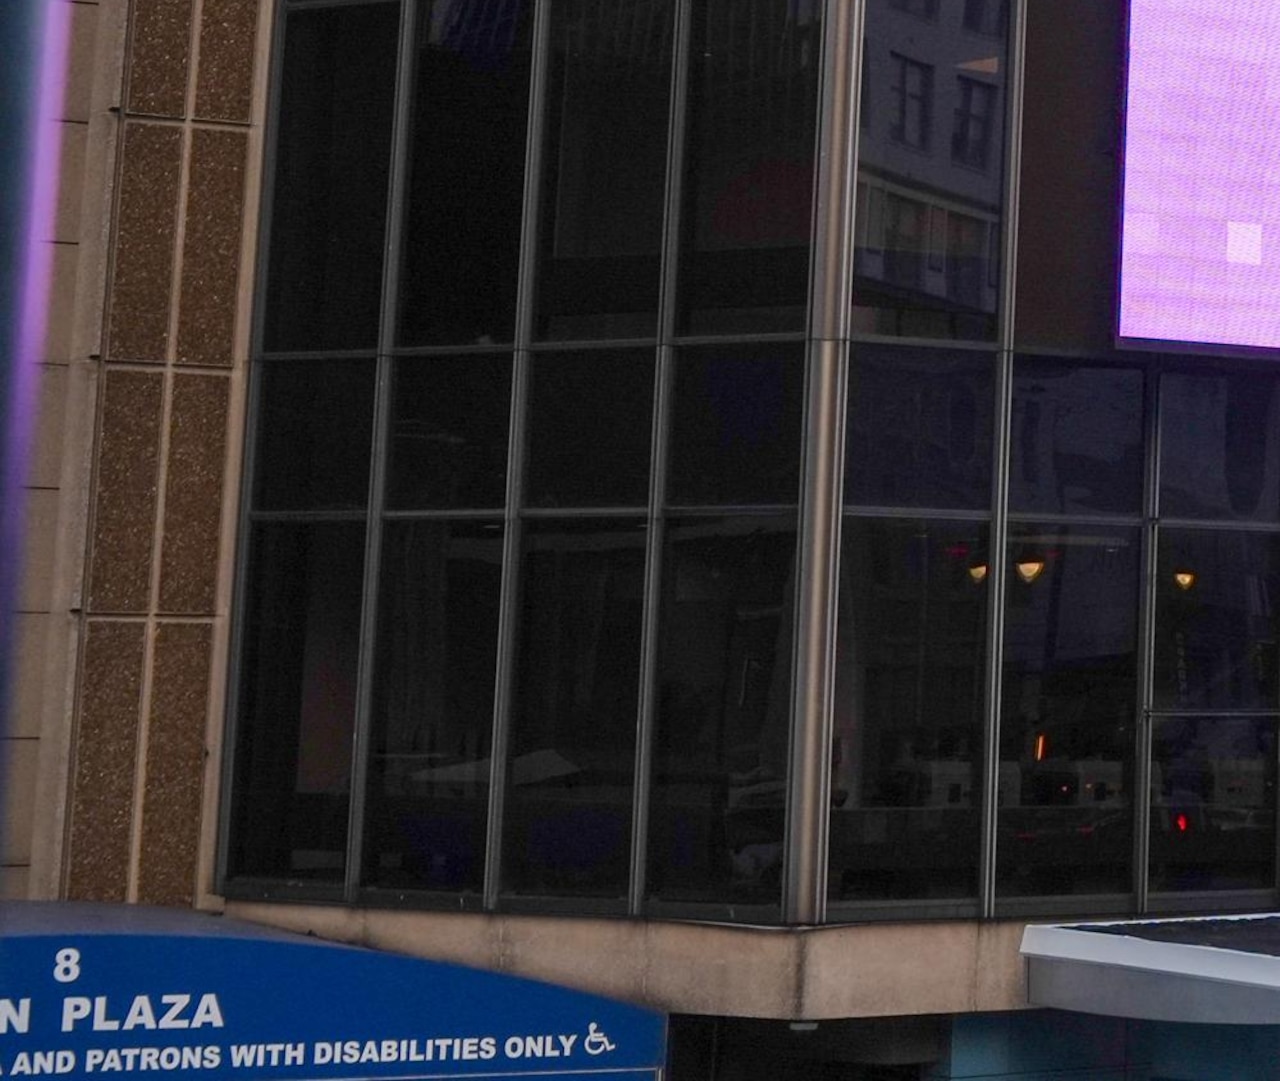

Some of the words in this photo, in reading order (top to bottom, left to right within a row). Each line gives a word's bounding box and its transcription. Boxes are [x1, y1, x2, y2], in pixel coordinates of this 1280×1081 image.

[53, 948, 81, 983] 8
[61, 993, 224, 1032] PLAZA
[10, 1050, 76, 1076] AND
[85, 1046, 221, 1073] PATRONS
[230, 1042, 305, 1068] WITH
[313, 1037, 497, 1065] DISABILITIES
[504, 1034, 578, 1059] ONLY
